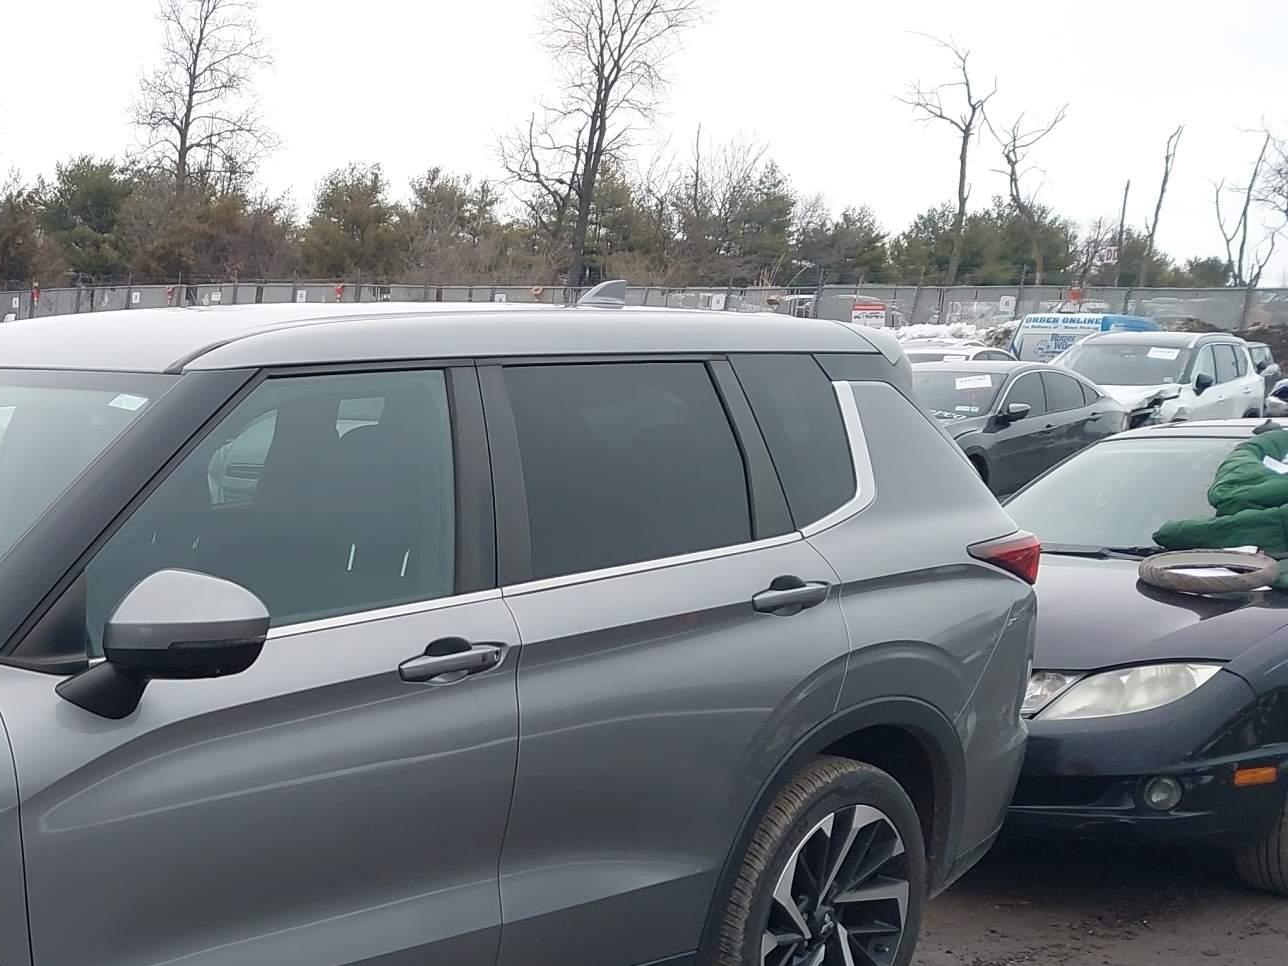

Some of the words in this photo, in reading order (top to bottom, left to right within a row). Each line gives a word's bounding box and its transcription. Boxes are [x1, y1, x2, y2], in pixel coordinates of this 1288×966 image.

[1025, 316, 1059, 324] ORDER
[1062, 317, 1103, 325] ONLINE
[1053, 342, 1074, 350] Wilc
